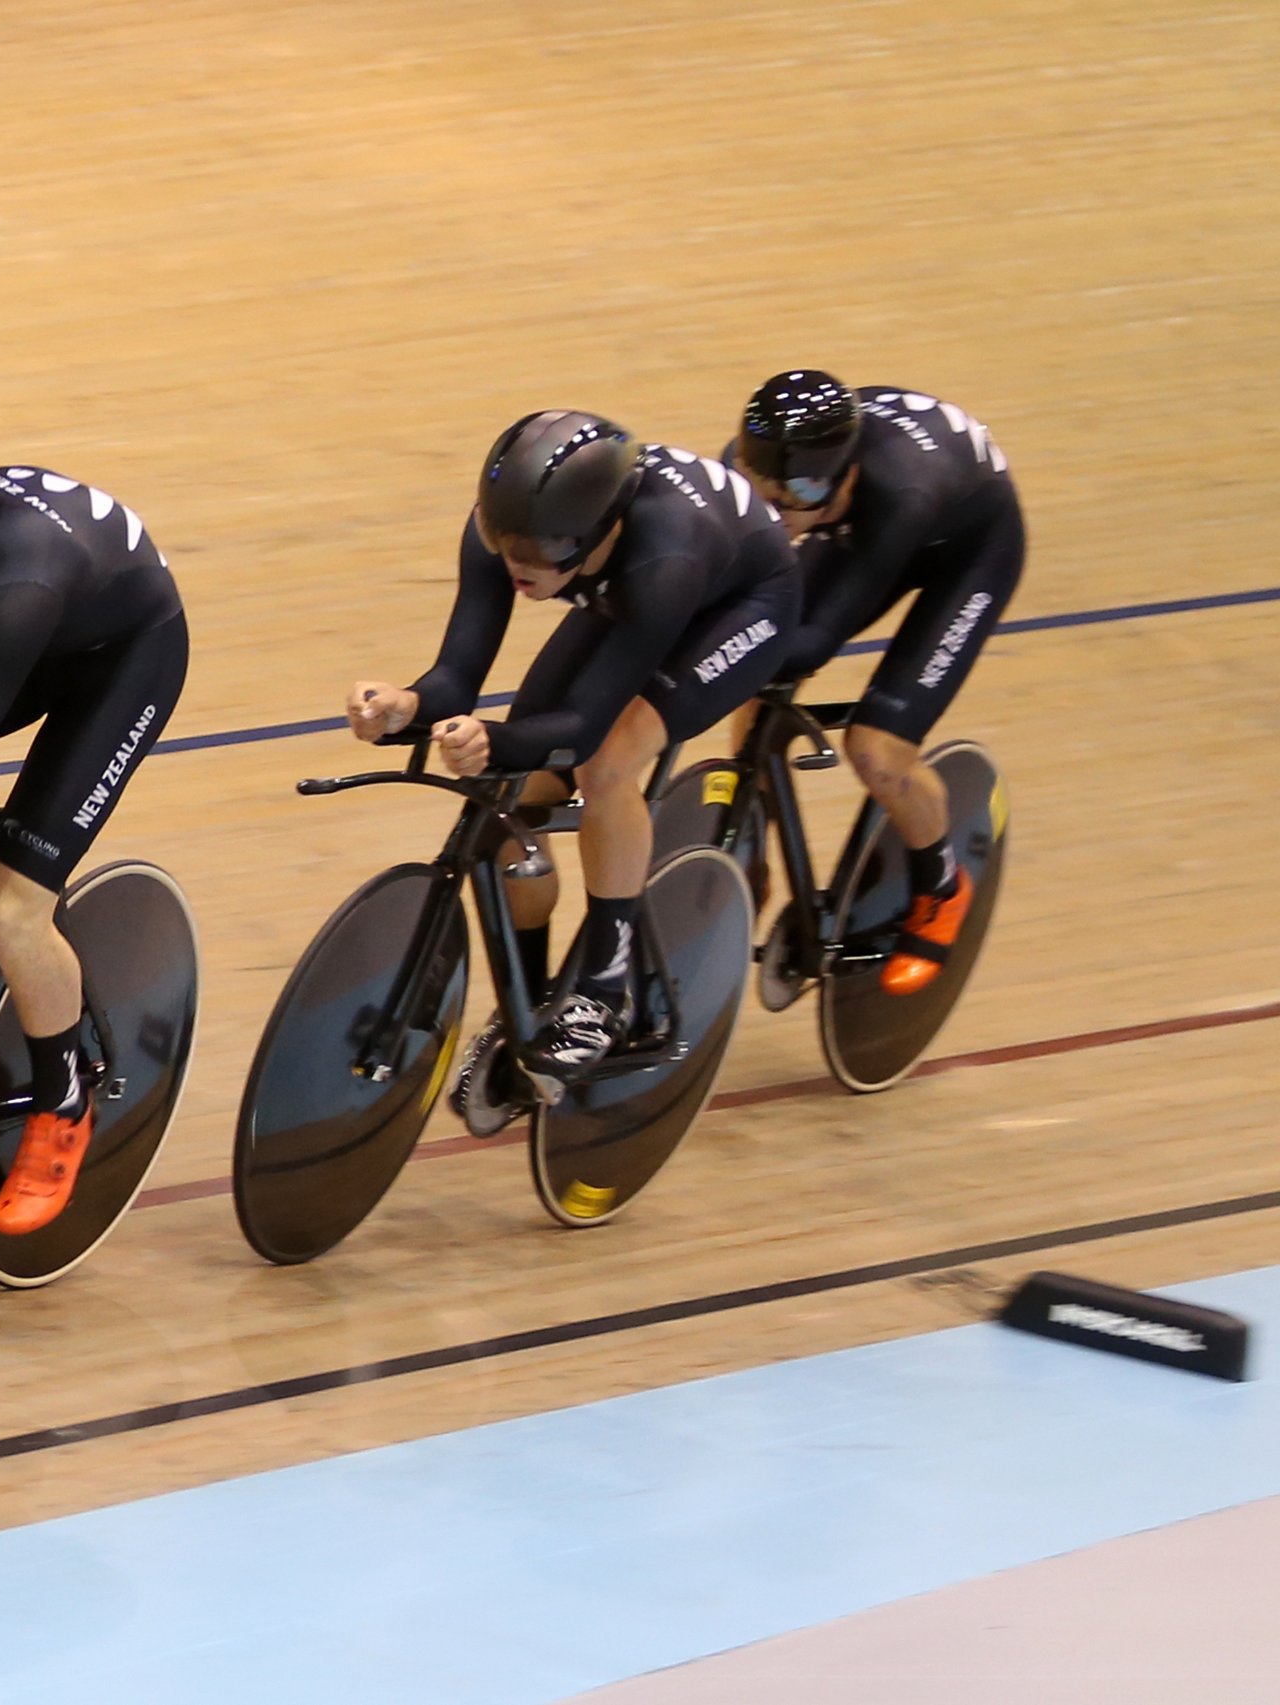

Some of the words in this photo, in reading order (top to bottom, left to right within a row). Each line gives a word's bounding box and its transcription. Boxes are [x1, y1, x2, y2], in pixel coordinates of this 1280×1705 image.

[693, 649, 729, 685] NEW
[719, 618, 778, 665] ZEALAND
[72, 783, 111, 830] NEW
[101, 703, 157, 787] ZEALAND
[20, 830, 61, 858] CYCLING
